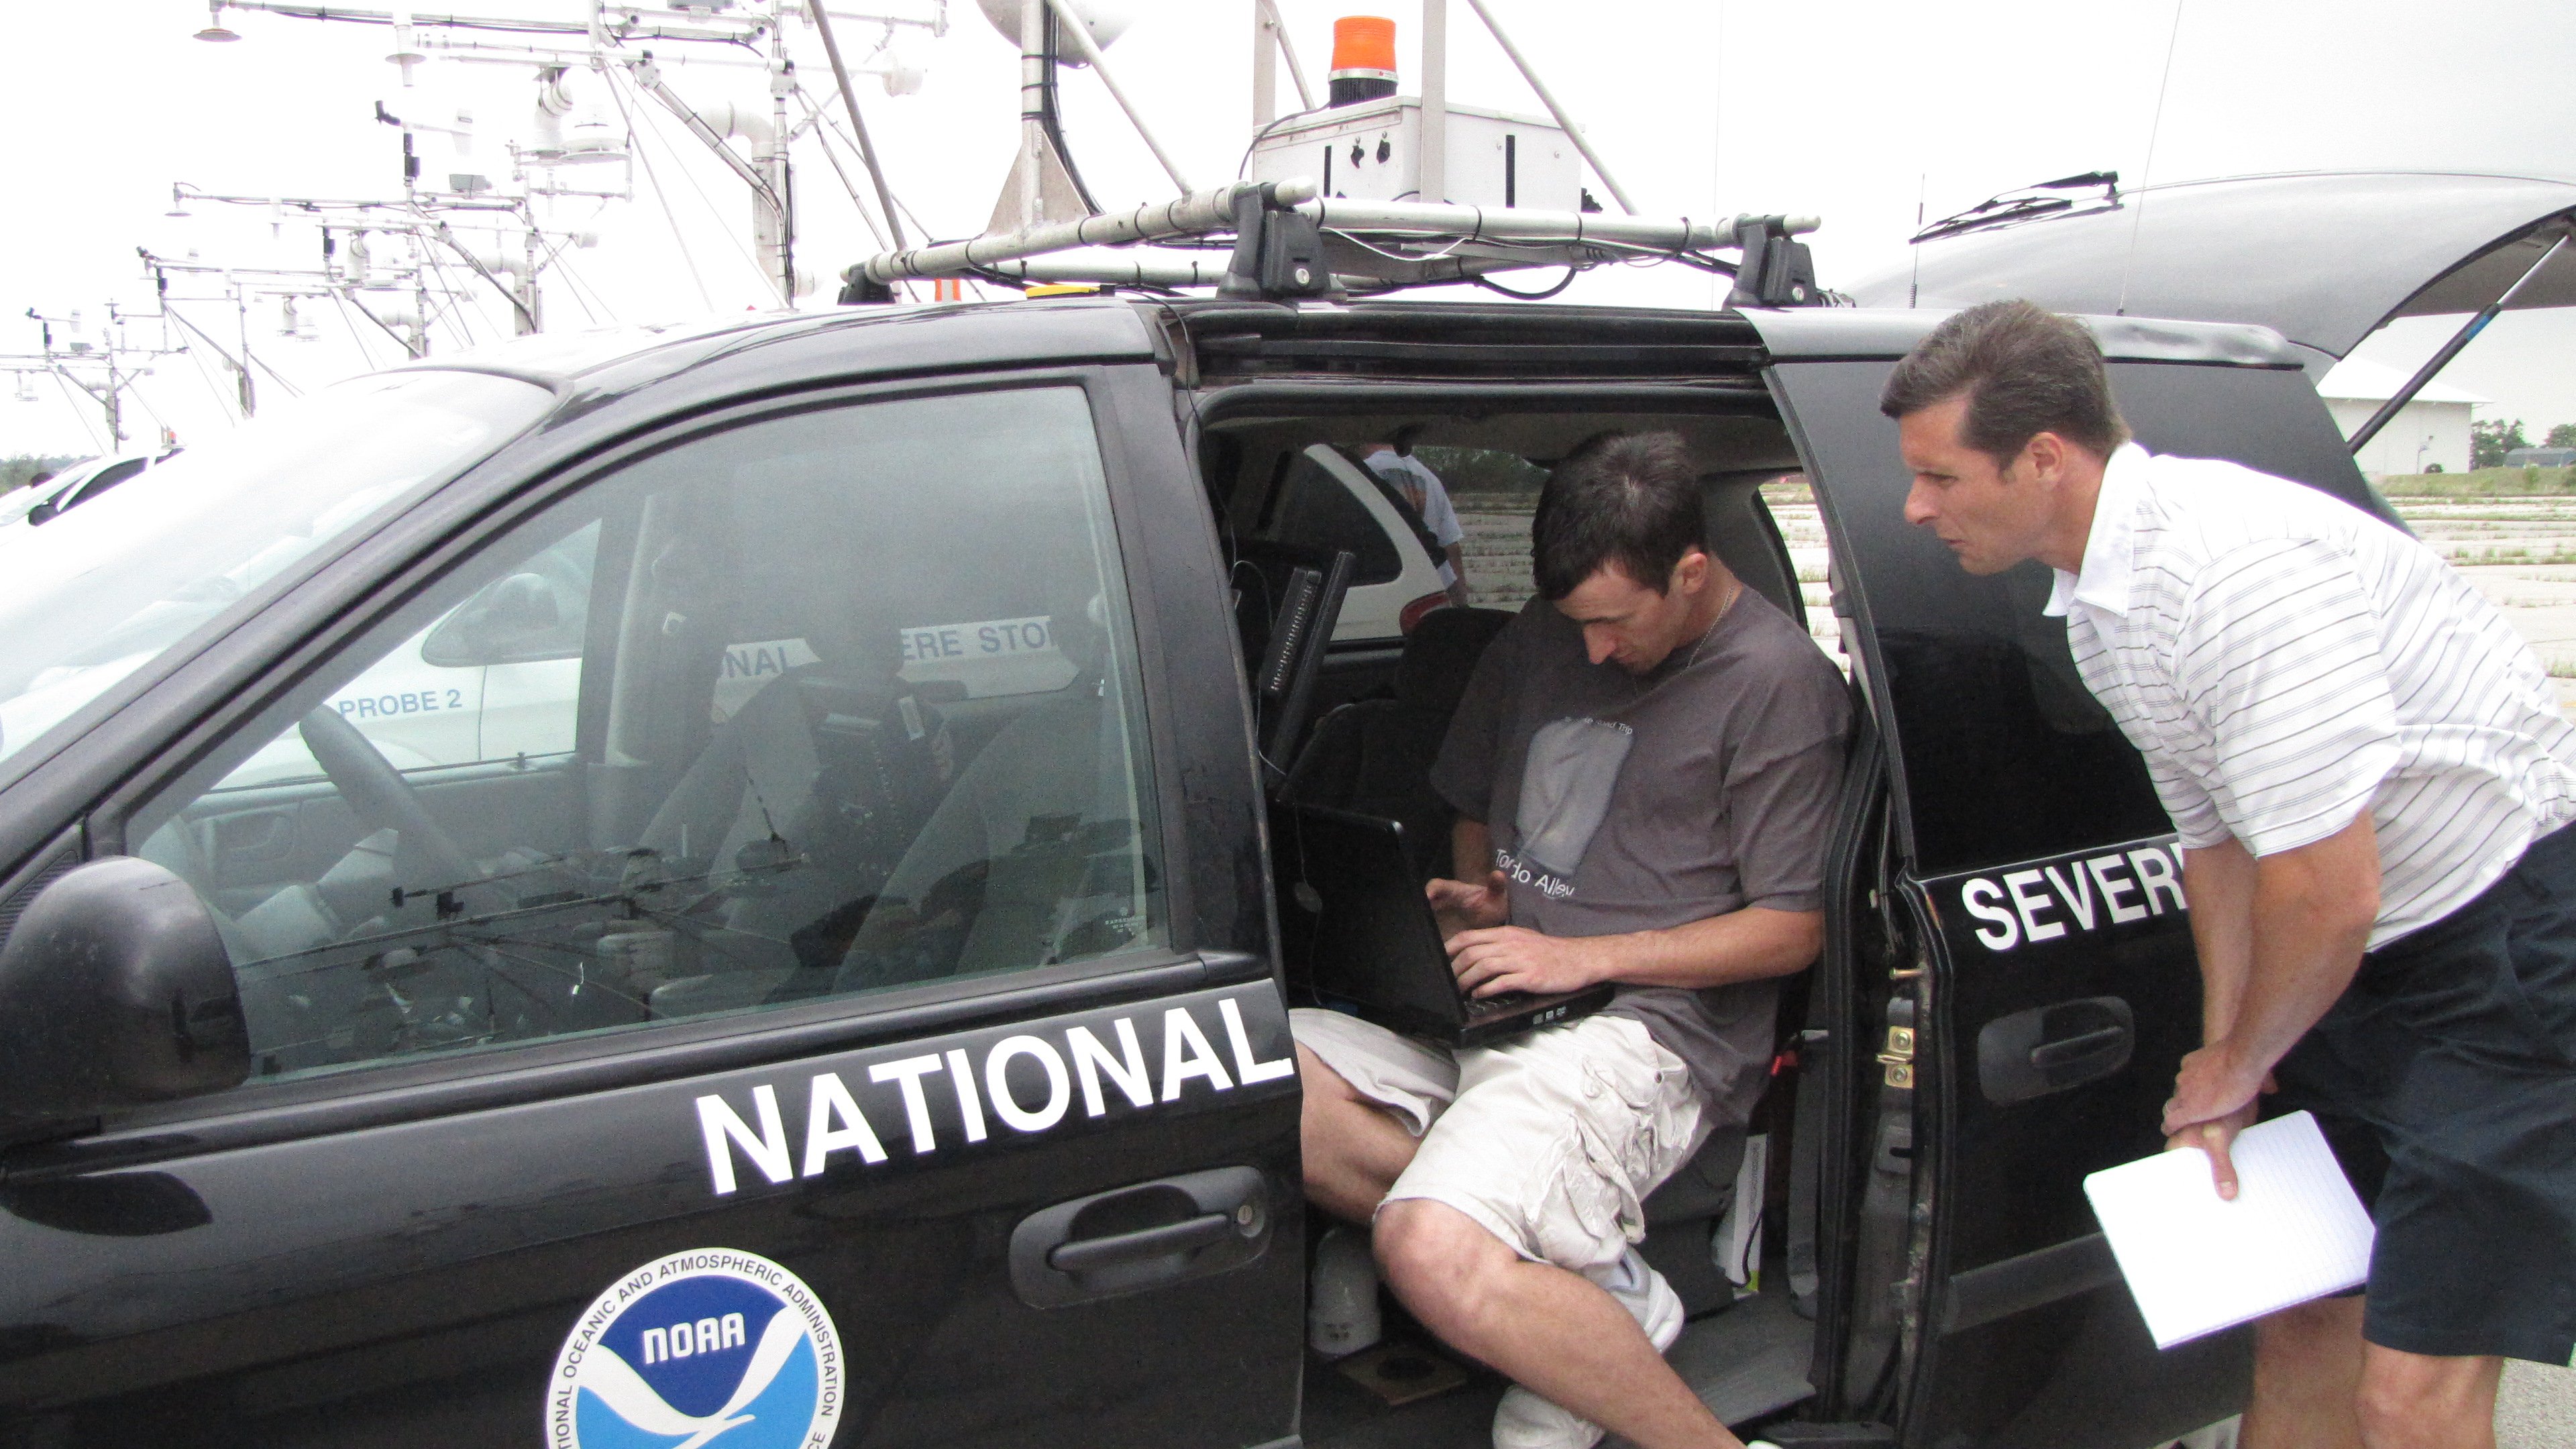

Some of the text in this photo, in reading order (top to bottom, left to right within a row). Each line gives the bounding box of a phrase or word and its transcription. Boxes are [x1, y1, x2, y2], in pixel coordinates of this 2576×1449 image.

[978, 621, 1053, 653] STO
[339, 689, 462, 718] PROBE 2
[1961, 841, 2188, 951] SEVER
[696, 998, 1295, 1195] NATIONAL
[563, 1300, 616, 1379] OCEANIC
[619, 1271, 653, 1303] AND
[659, 1254, 783, 1286] ATMOSPHERIC
[782, 1283, 838, 1416] ADMINISTRATION
[643, 1312, 746, 1365] NOAA
